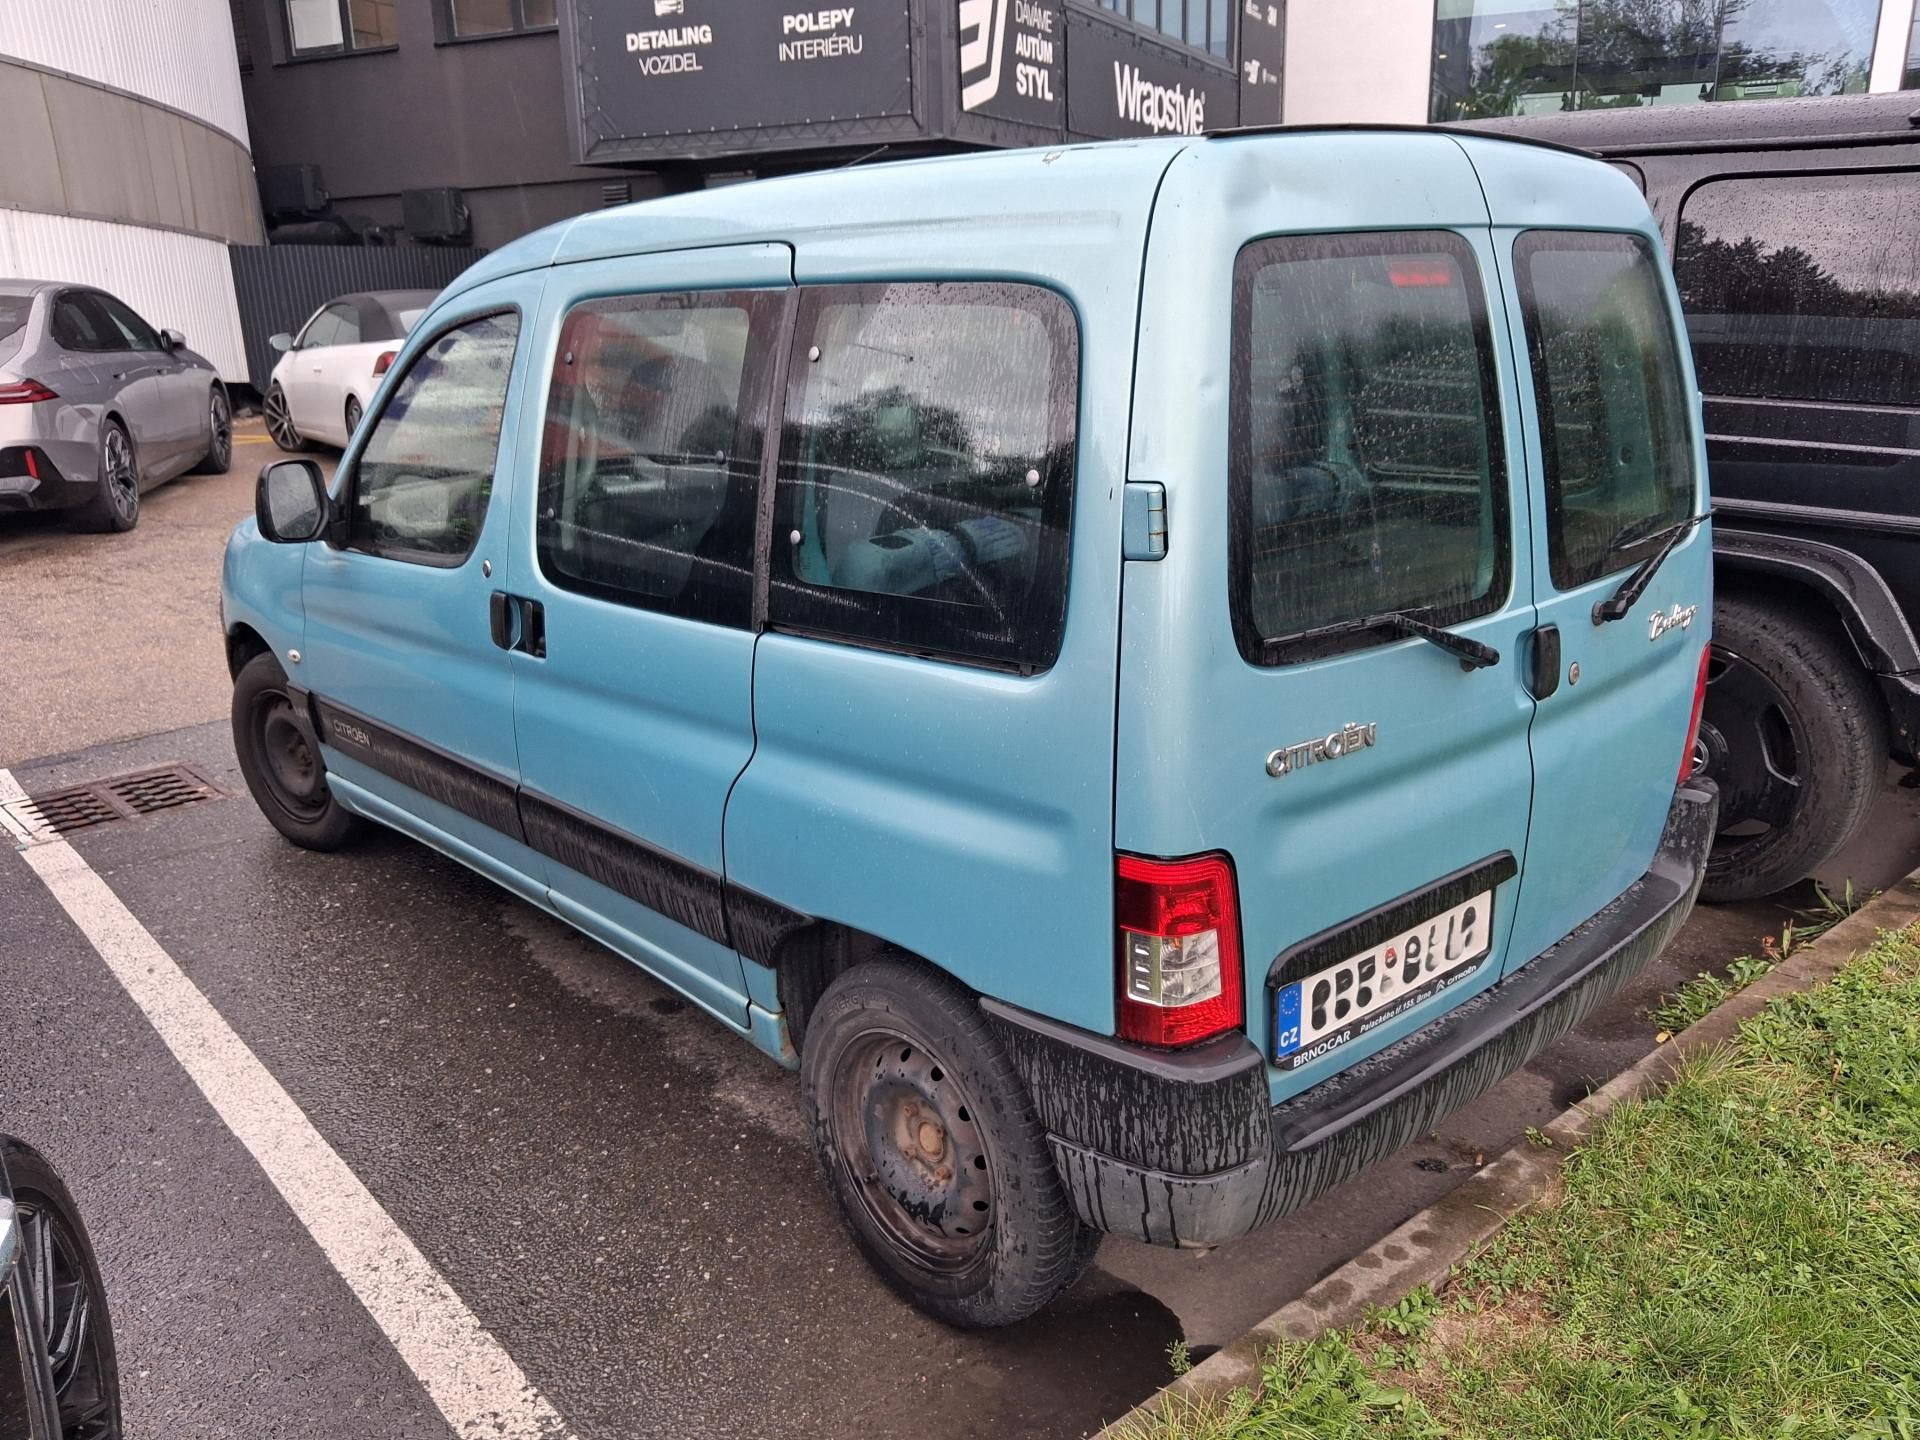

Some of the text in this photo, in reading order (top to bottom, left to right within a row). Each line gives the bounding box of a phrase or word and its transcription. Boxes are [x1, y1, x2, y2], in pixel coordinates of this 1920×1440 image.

[783, 7, 855, 35] POLEPY
[1015, 0, 1053, 33] DÁVÁME
[626, 24, 713, 52] DETAILING
[779, 32, 863, 62] INTERIÉRU
[639, 52, 703, 75] VOZIDEL
[1016, 62, 1053, 101] STYL
[333, 719, 370, 747] CITROËN
[1266, 722, 1377, 777] CITROËN
[1280, 1026, 1298, 1048] CZ
[1293, 1030, 1351, 1068] BRNOCAR
